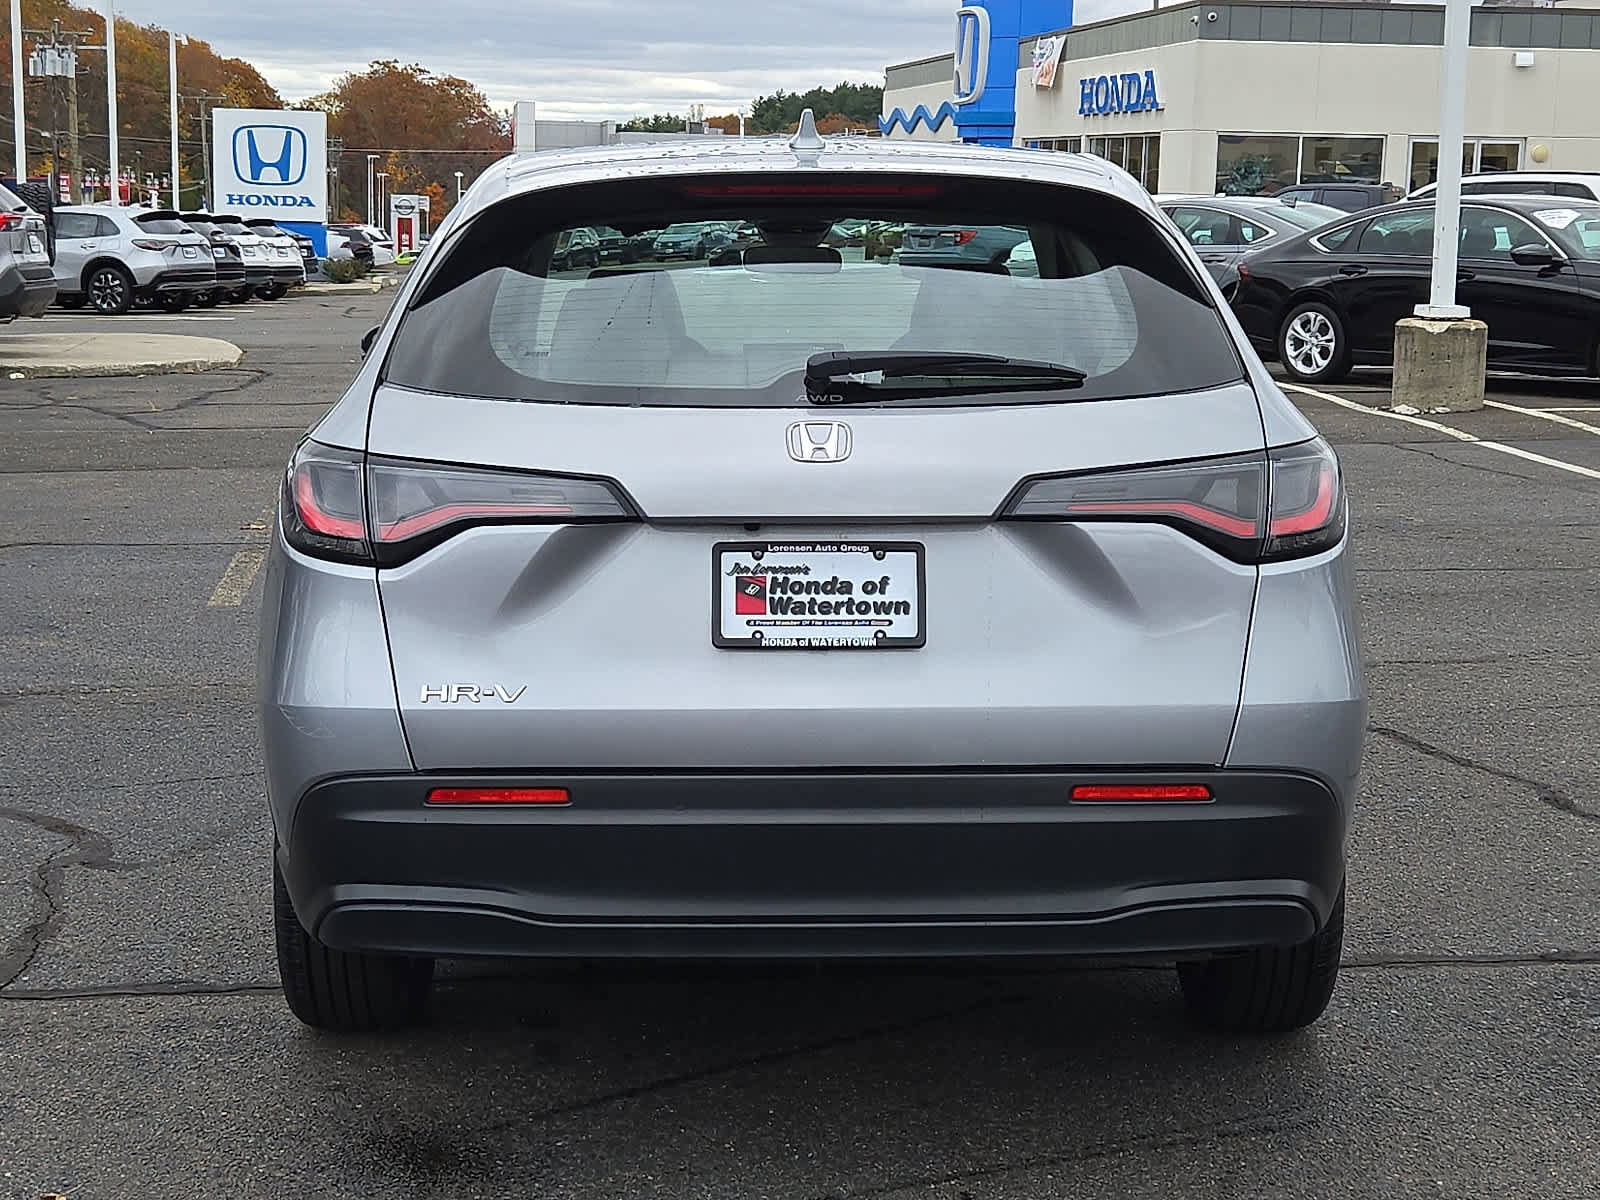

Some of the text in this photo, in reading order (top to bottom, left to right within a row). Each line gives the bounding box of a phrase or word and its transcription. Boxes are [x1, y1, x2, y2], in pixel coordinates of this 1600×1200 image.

[1079, 70, 1160, 115] HONDA
[226, 193, 316, 208] HONDA
[795, 394, 844, 402] AWD
[767, 543, 870, 553] Lorensen Auto Group
[769, 575, 890, 595] Honda of
[769, 596, 911, 616] Watertown
[761, 638, 877, 647] HONDA of WATERTOWN
[420, 683, 527, 703] HR-V
